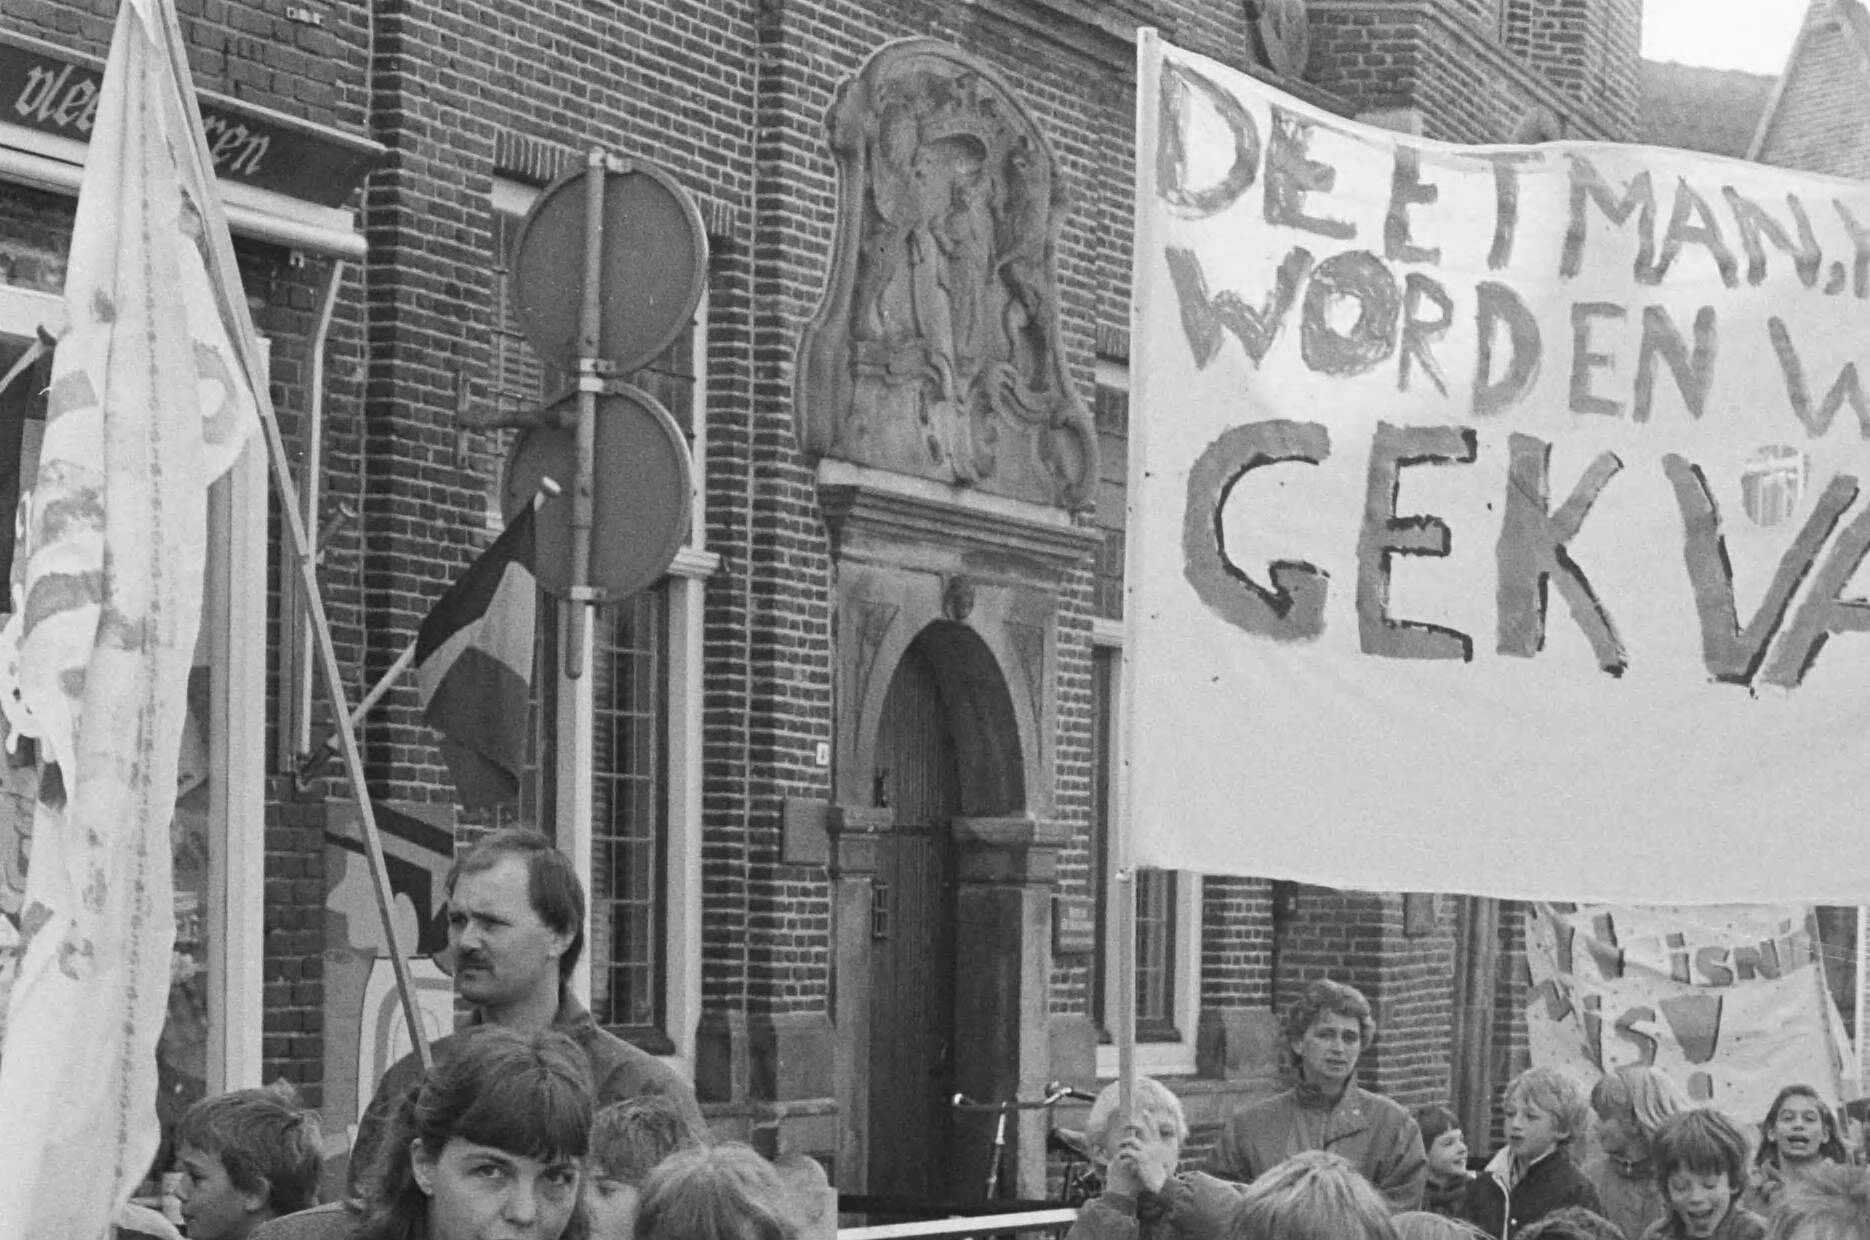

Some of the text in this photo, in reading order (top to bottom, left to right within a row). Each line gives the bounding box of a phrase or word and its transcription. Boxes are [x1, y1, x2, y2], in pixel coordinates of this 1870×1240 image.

[14, 64, 271, 176] vleeren
[1166, 246, 1717, 422] WORDEN
[1182, 420, 1628, 680] GEK
